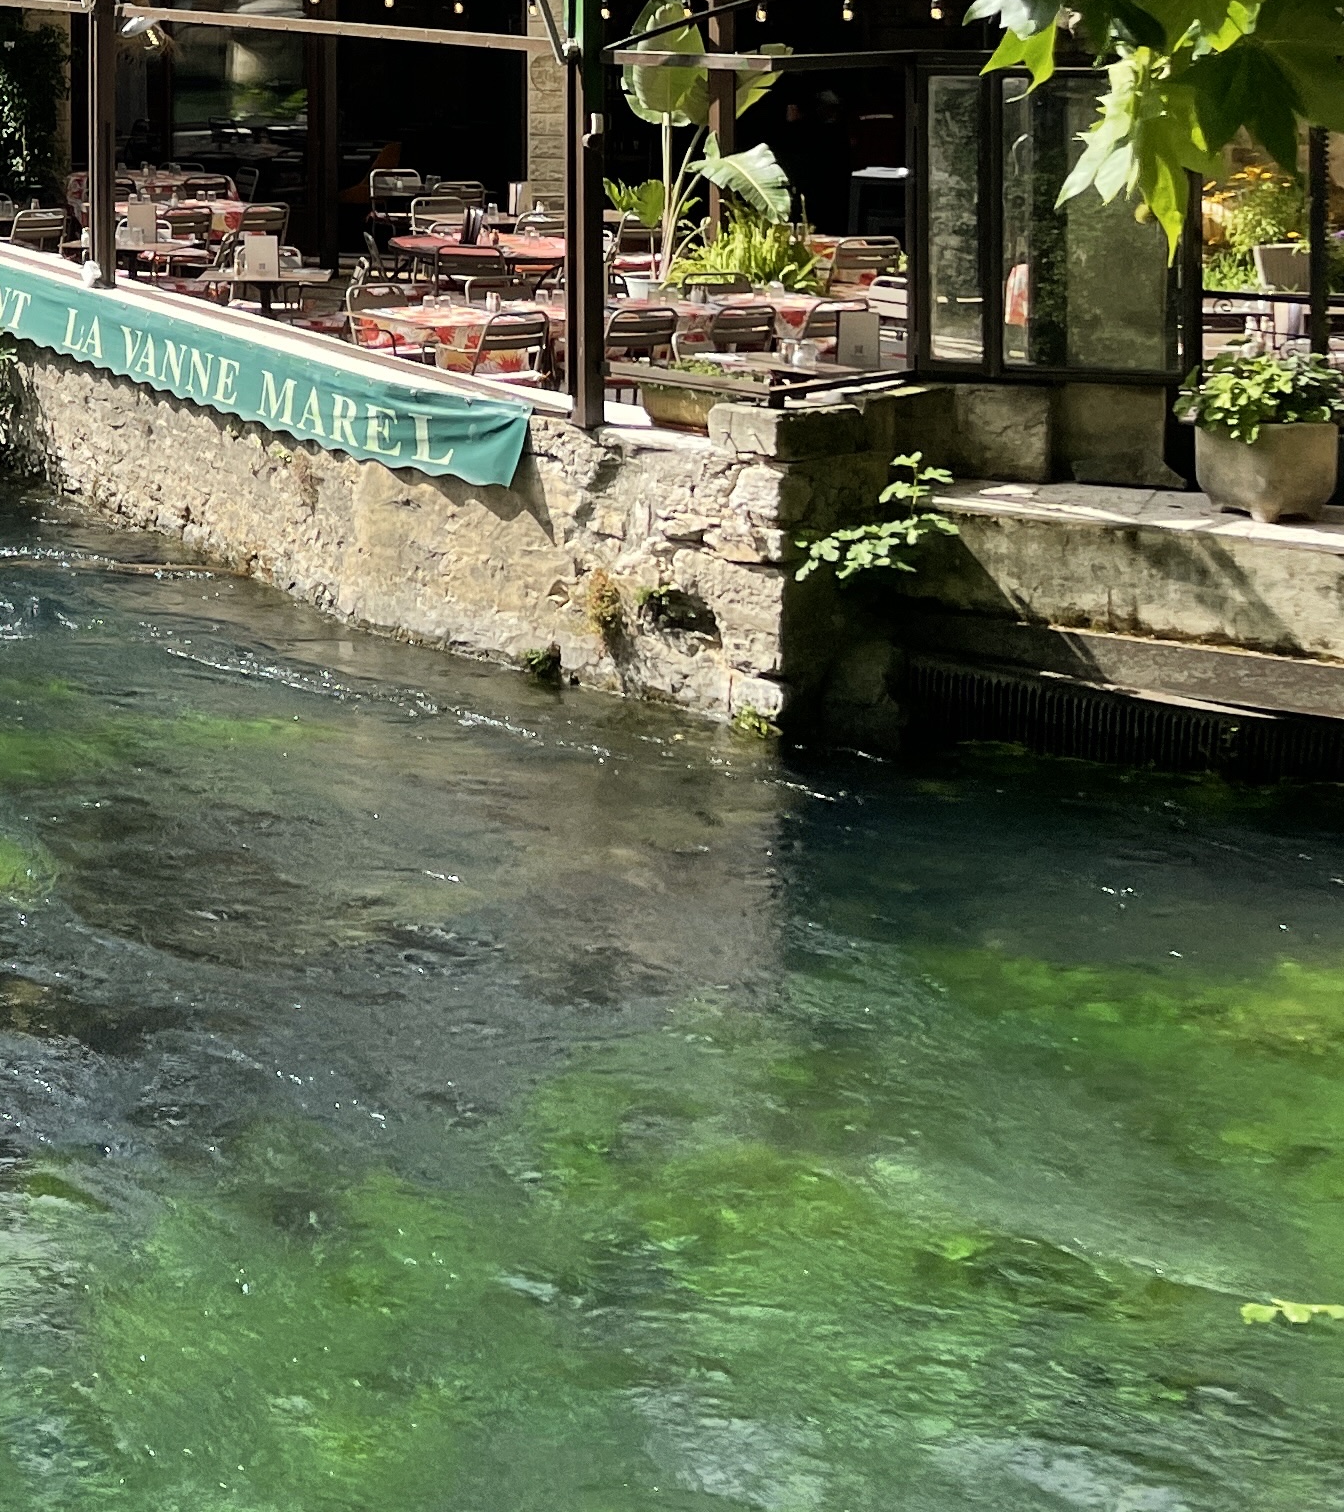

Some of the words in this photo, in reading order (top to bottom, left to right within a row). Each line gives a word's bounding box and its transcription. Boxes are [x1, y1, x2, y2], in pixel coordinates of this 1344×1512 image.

[61, 307, 104, 359] LA
[120, 324, 240, 406] VANNE
[259, 369, 455, 466] MAREL
